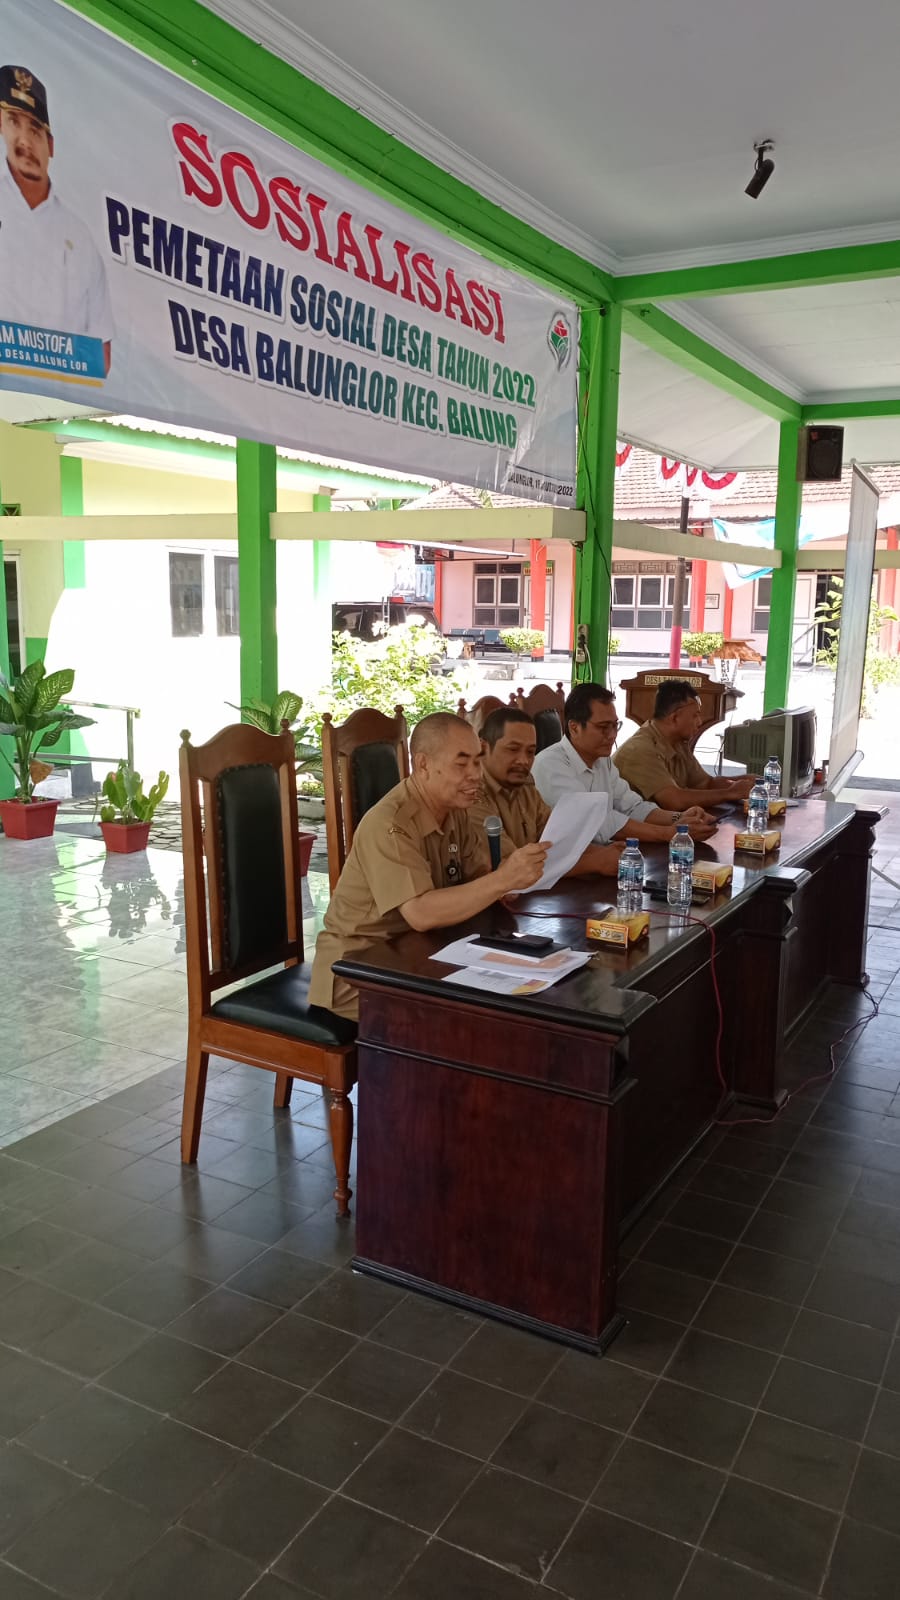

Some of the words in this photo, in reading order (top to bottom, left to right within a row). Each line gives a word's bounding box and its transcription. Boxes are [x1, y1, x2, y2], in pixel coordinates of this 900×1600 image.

[171, 122, 506, 344] SOSIALISASI
[0, 325, 15, 345] M
[17, 328, 73, 356] MUSTOFA
[105, 196, 285, 317] PEMETAAN
[290, 275, 377, 352] SOSIAL
[382, 313, 432, 373] DESA
[437, 336, 490, 395] TAHUN
[492, 362, 536, 407] 2022
[5, 348, 31, 361] DESA
[33, 352, 68, 369] BALUNG
[70, 360, 88, 372] LOR
[168, 299, 251, 376] DESA
[255, 331, 398, 419] BALUNGLOR
[401, 381, 444, 432] KEC.
[447, 397, 518, 449] BALUNG
[557, 485, 573, 496] 2022
